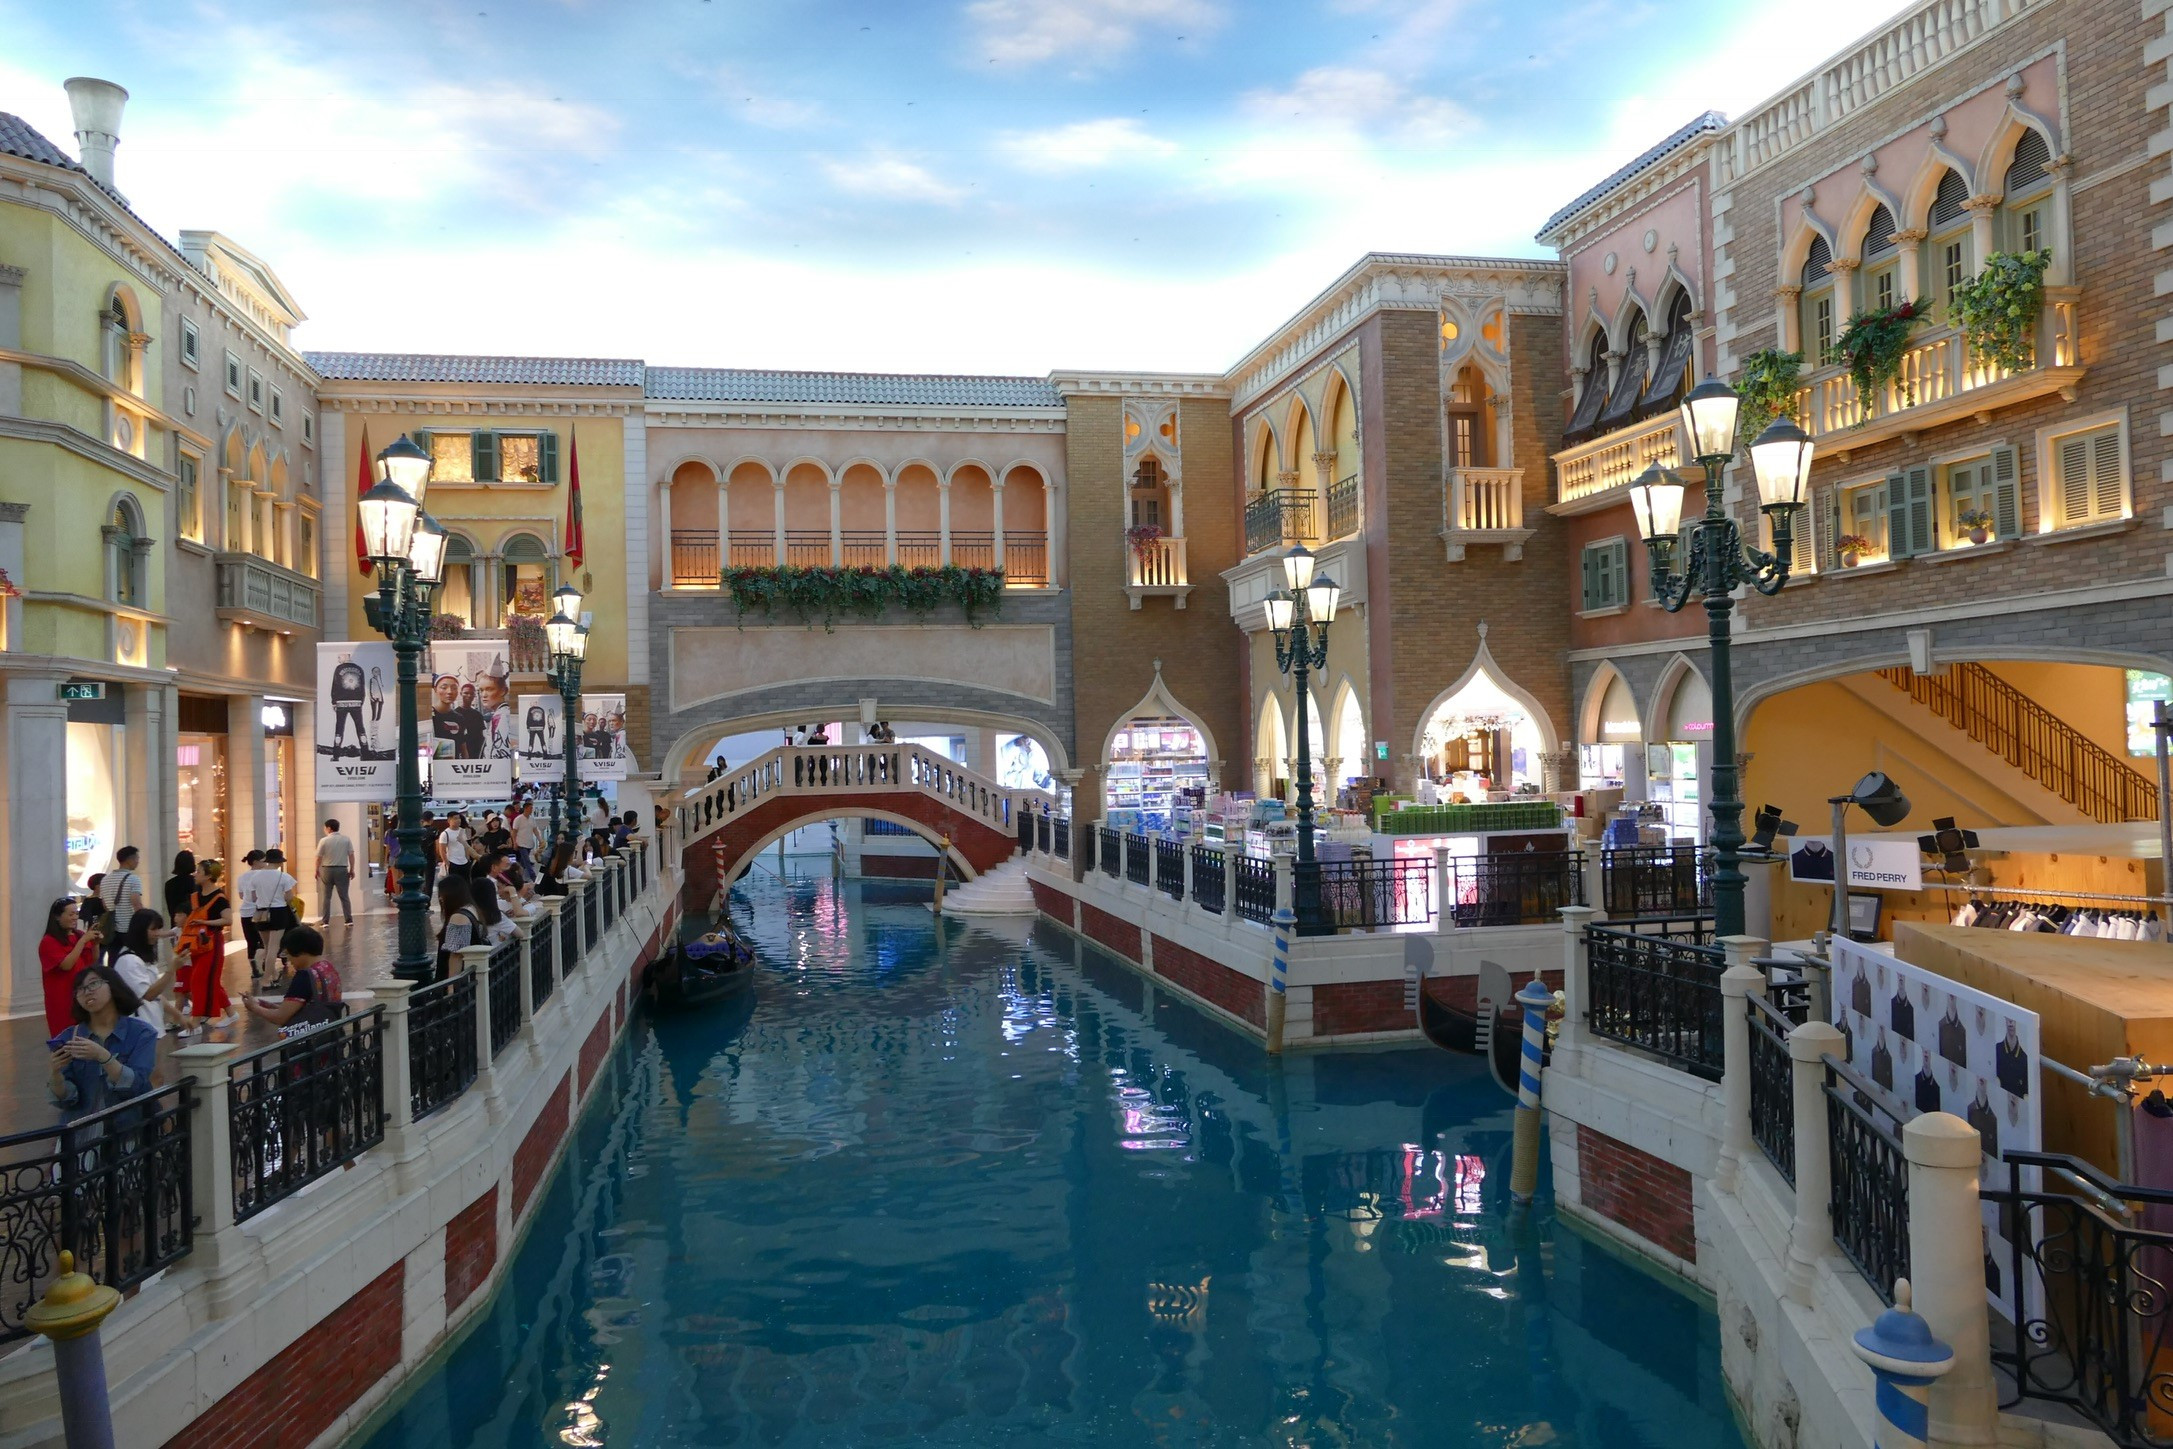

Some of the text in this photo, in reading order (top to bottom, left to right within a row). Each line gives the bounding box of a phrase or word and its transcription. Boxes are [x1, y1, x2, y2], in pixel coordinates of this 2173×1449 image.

[335, 766, 377, 775] EVISU
[451, 764, 492, 774] EVISU
[1852, 871, 1907, 883] FRED PERRY
[288, 1018, 329, 1037] Thailand
